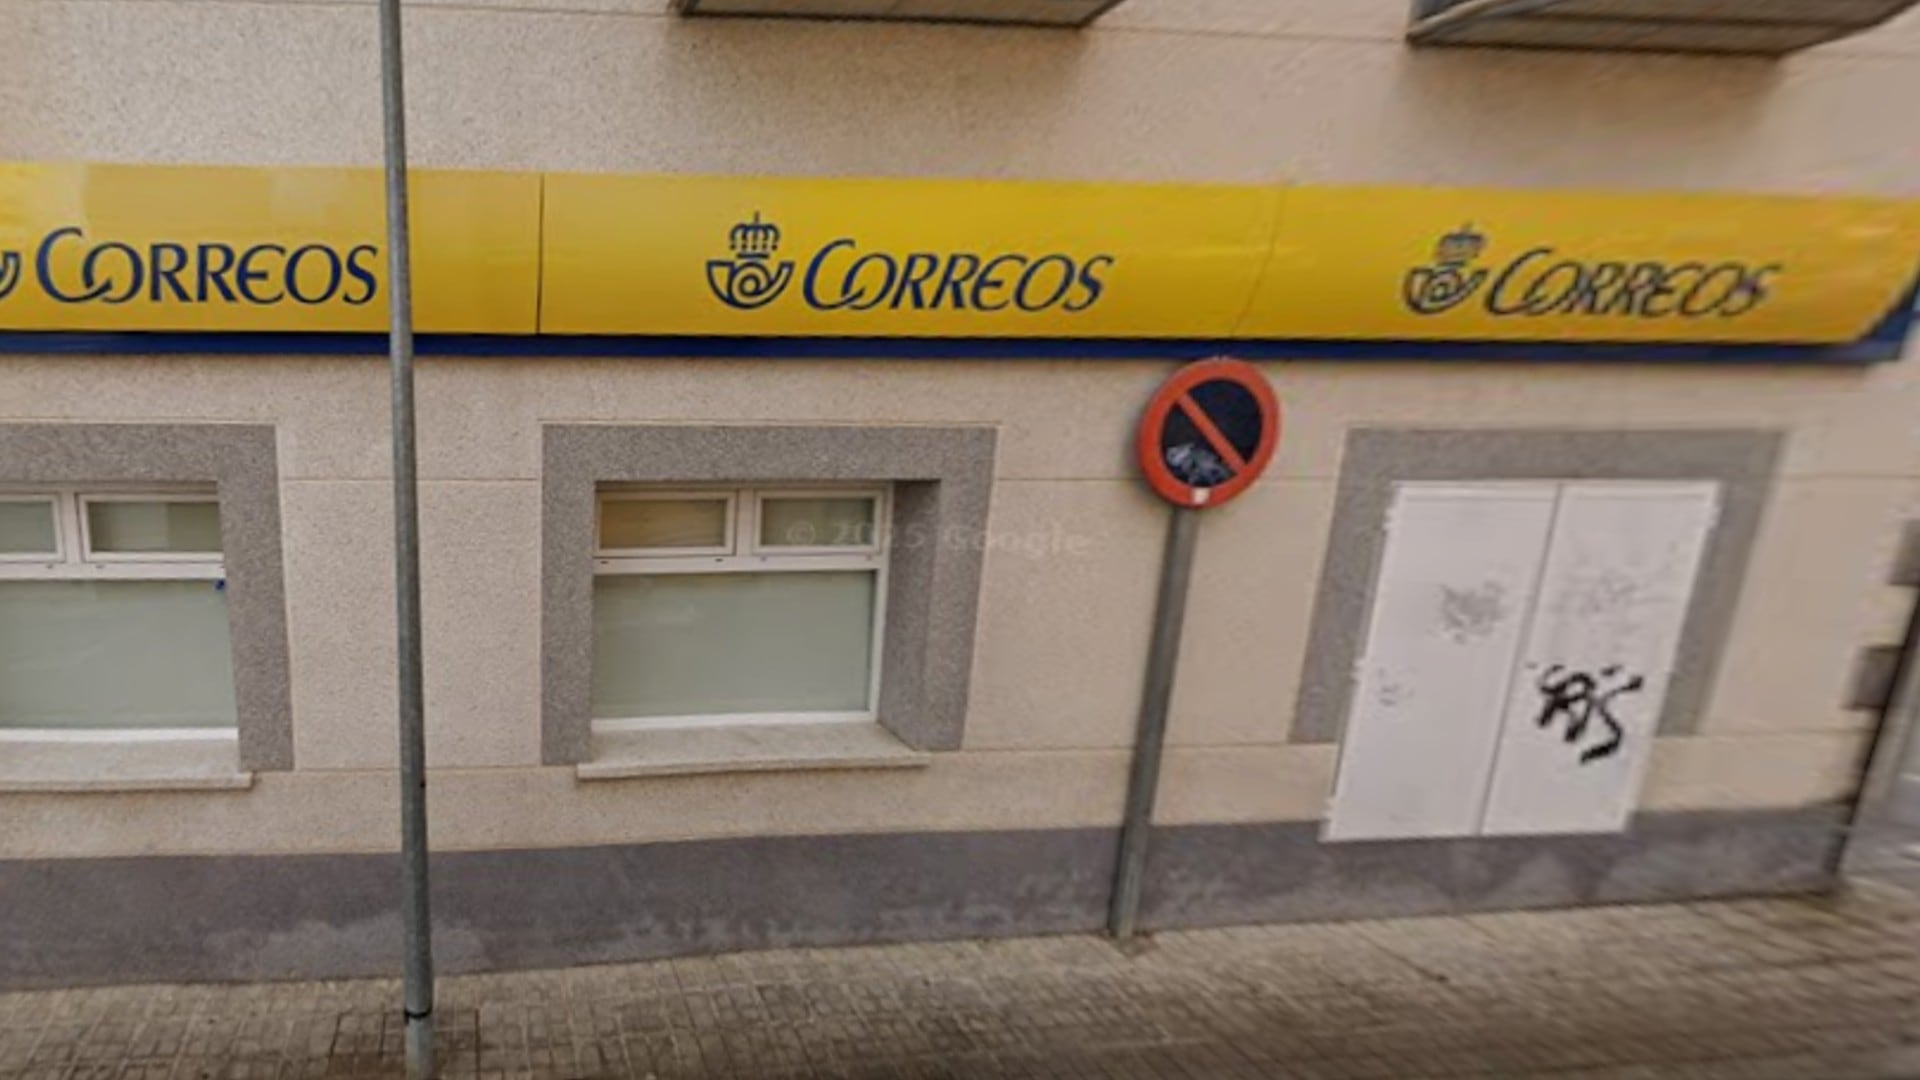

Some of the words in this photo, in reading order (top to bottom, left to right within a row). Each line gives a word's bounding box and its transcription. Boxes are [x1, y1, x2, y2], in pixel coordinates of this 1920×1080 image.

[36, 228, 377, 305] CORREOS
[803, 239, 1114, 312] CORREOS
[1485, 248, 1781, 318] CORREOS
